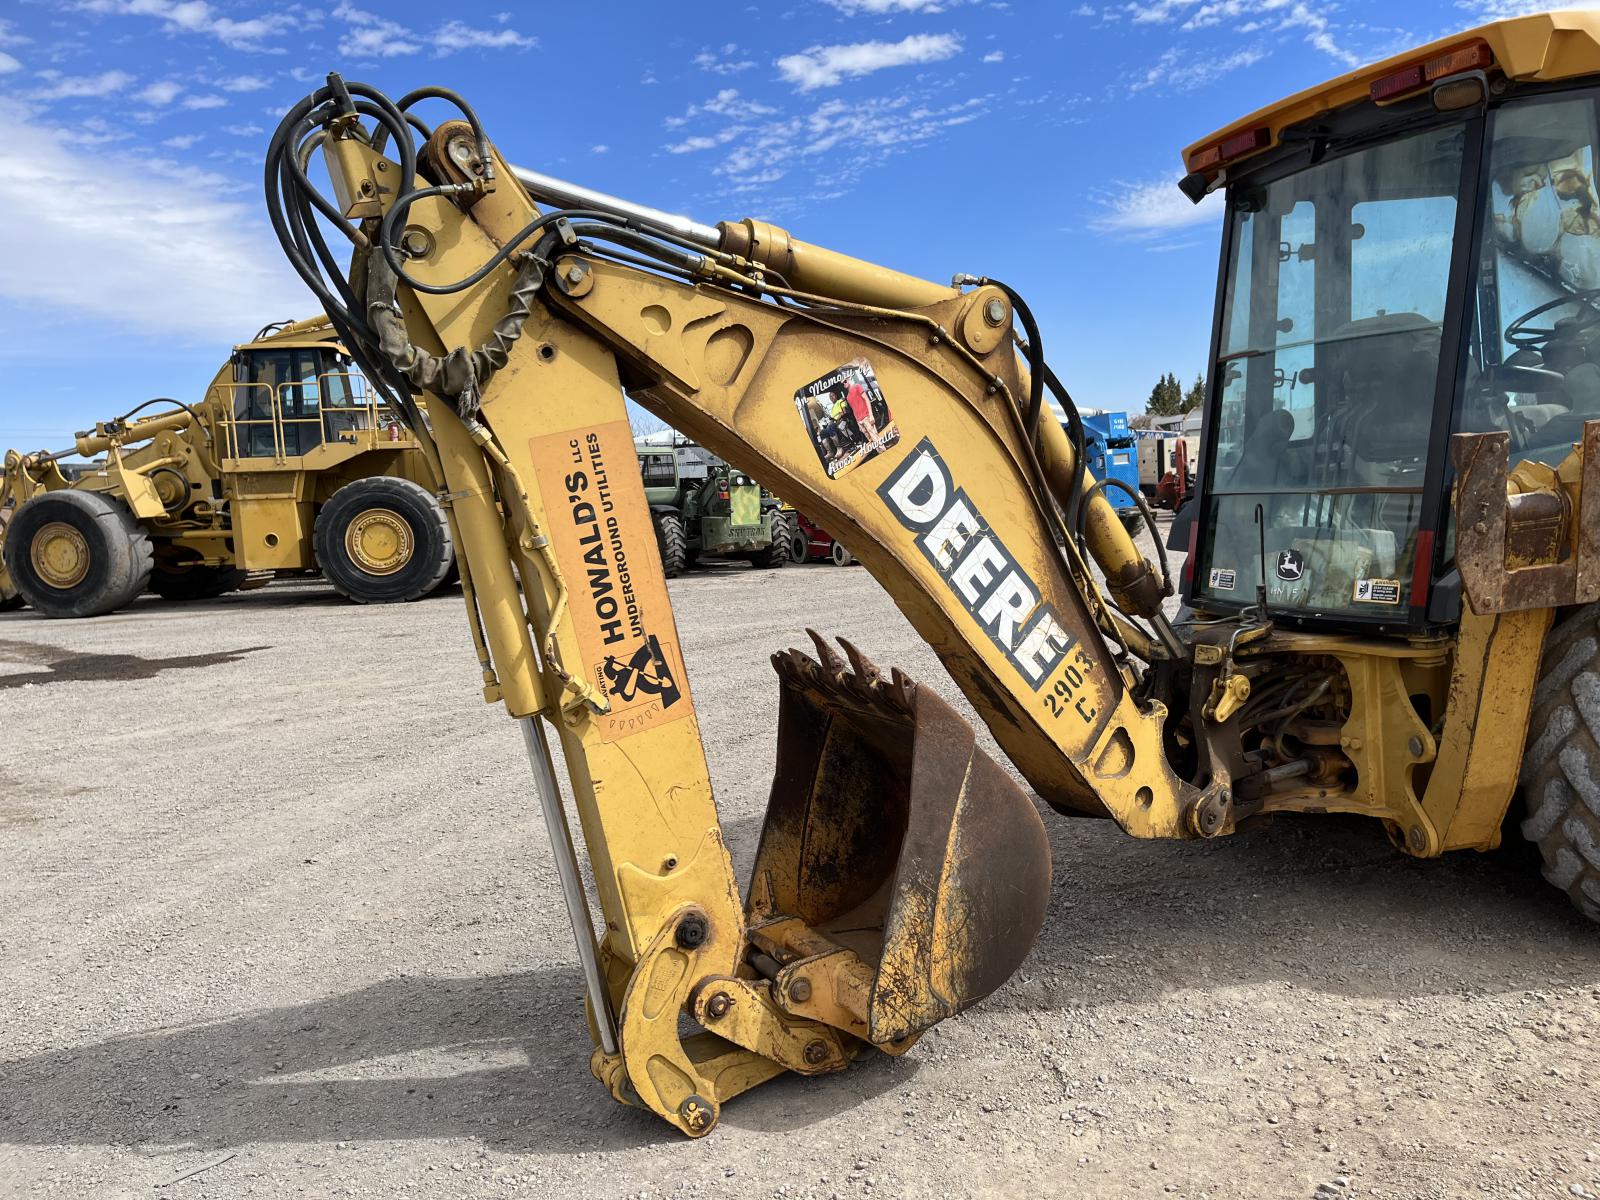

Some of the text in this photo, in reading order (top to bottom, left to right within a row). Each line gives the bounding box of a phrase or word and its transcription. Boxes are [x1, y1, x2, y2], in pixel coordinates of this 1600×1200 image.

[809, 369, 854, 397] Memory
[856, 428, 899, 457] Howald
[564, 438, 625, 646] HOWALD'S LLC
[586, 432, 642, 638] UNDERGROUND UTILITIES
[886, 448, 1071, 684] DEERE
[597, 667, 611, 712] AVATING
[1043, 650, 1095, 719] 2903
